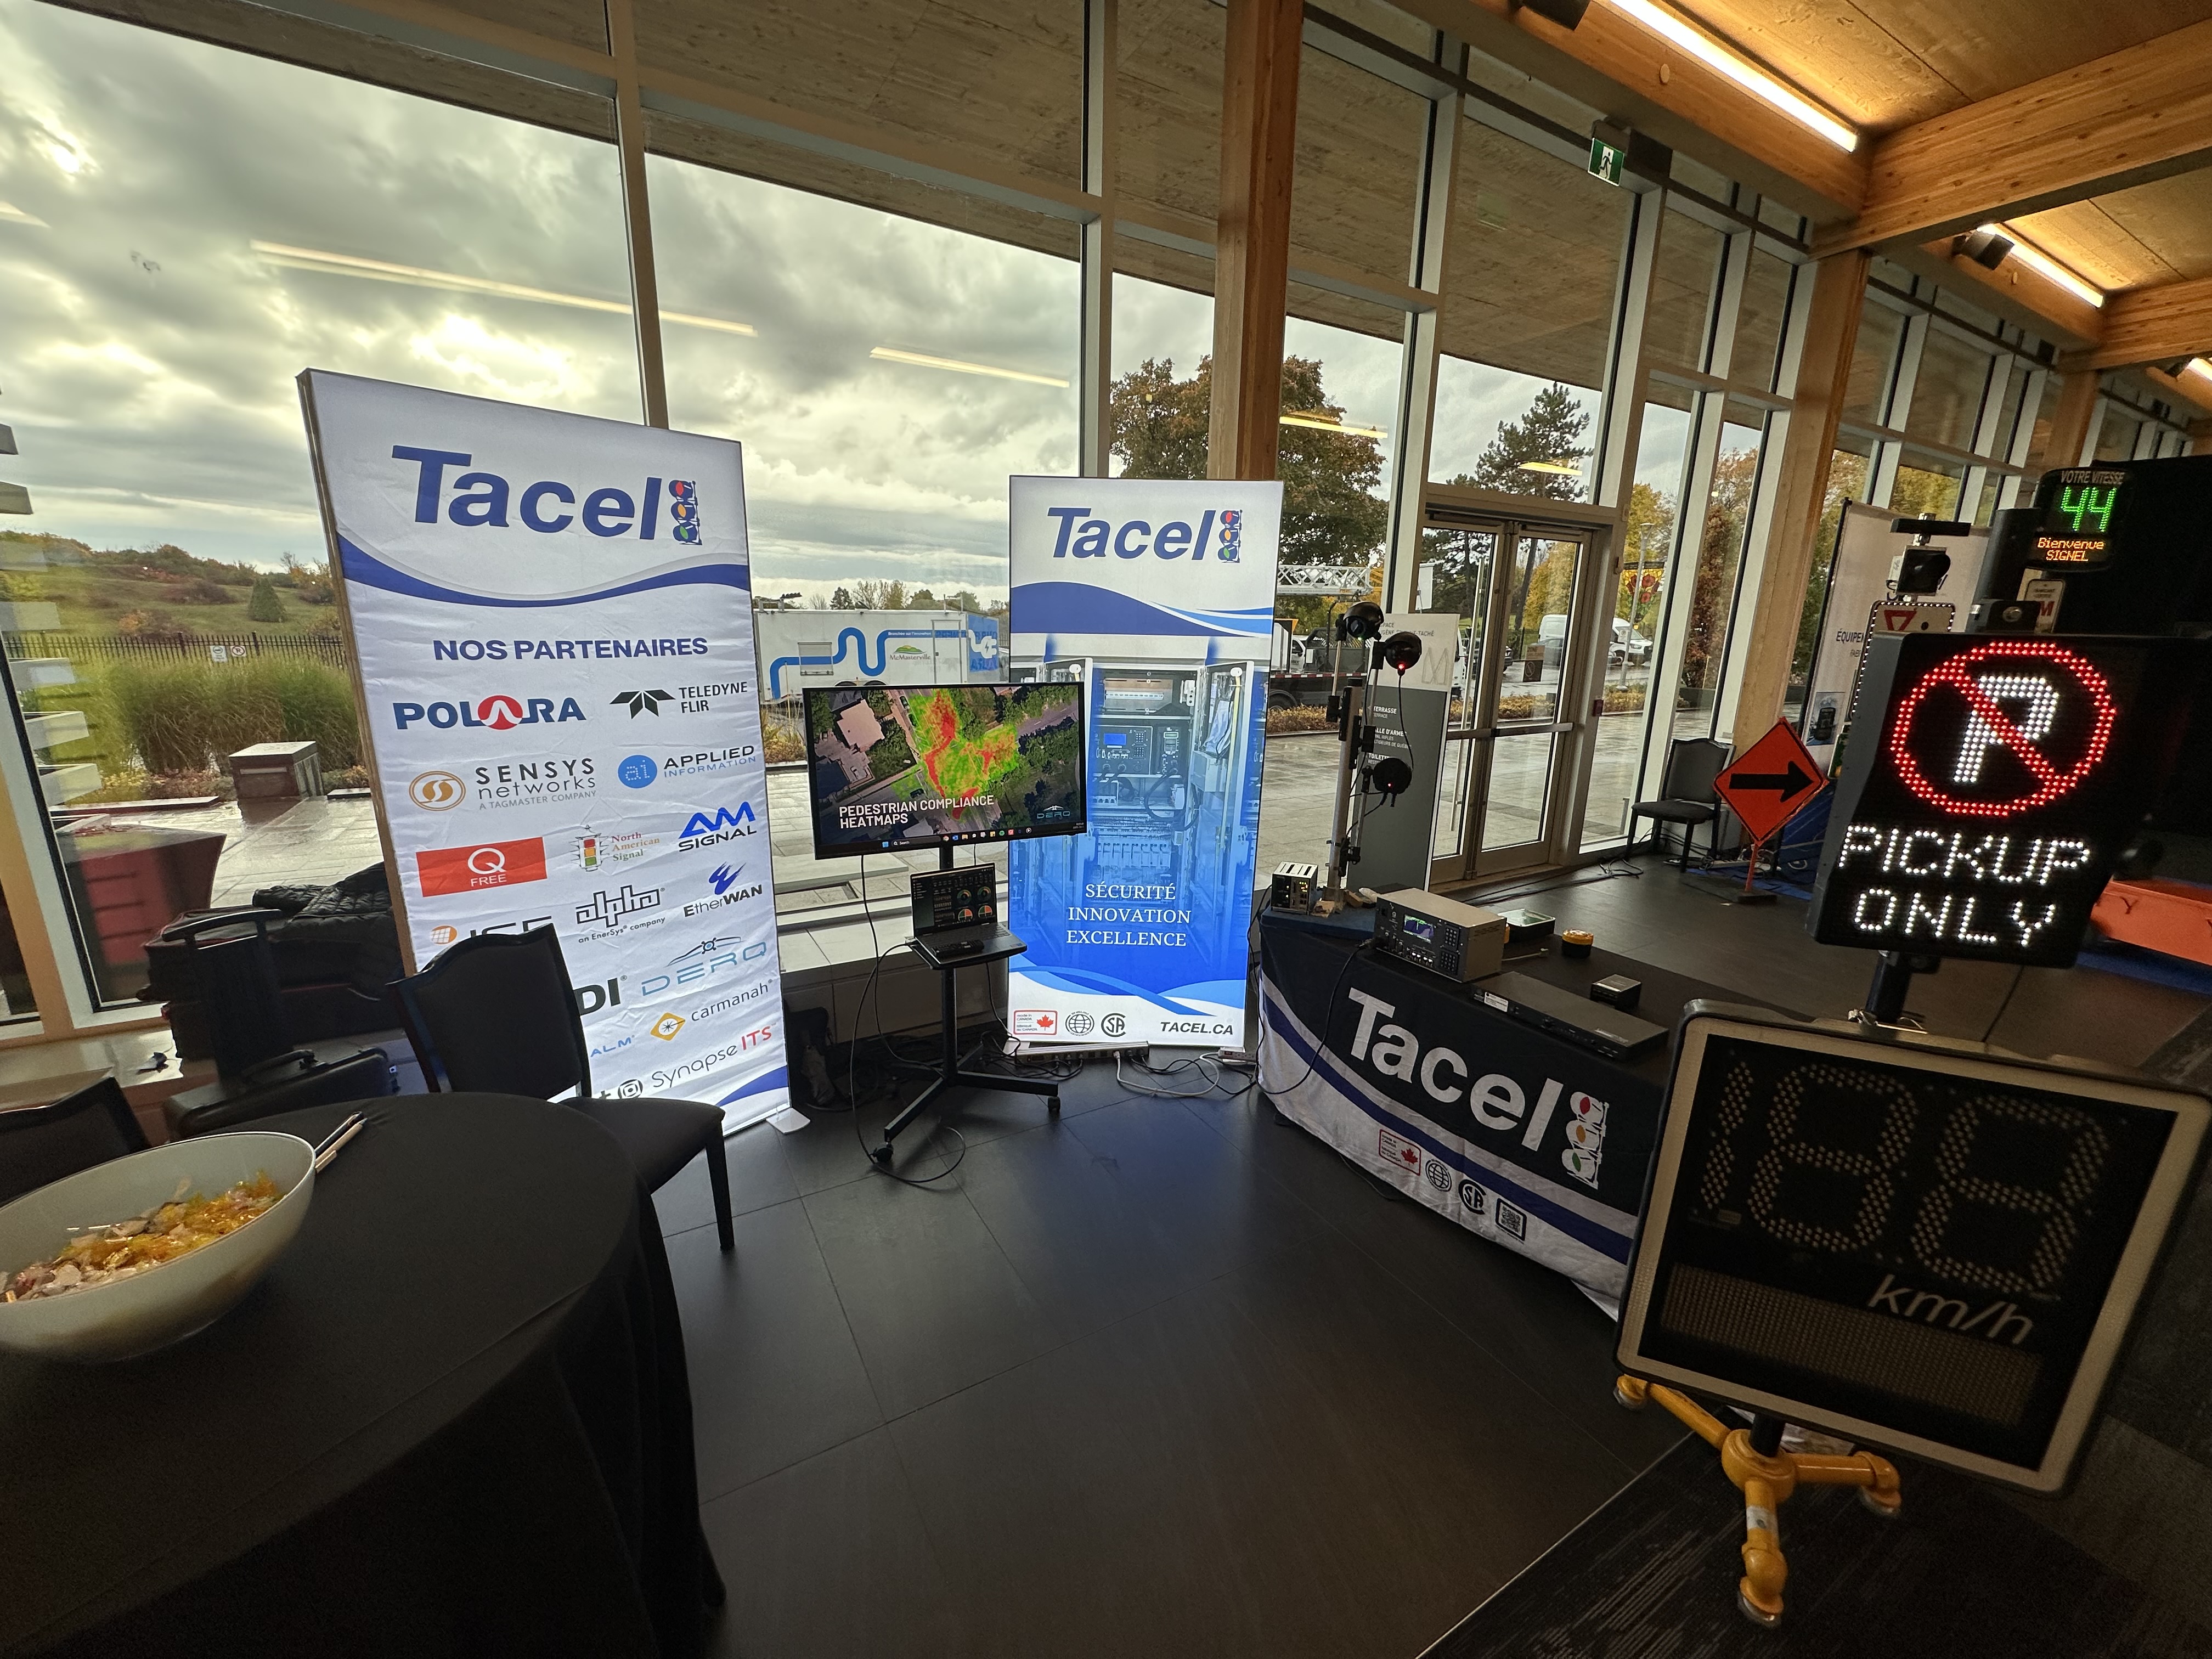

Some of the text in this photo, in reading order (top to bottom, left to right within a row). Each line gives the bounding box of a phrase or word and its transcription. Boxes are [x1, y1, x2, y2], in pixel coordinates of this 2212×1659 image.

[2061, 470, 2125, 485] VOTRE VITESSE
[392, 445, 662, 540] Tacel
[2060, 485, 2117, 533] 44
[1047, 507, 1216, 561] Tacel
[2037, 537, 2105, 550] Bienvenue
[2046, 550, 2089, 562] SIGNEL
[1836, 628, 1864, 644] ÉQUIPE
[433, 637, 708, 661] NOS PARTENAIRES
[679, 681, 748, 699] TELEDYNE
[393, 695, 586, 730] POLARA
[681, 700, 709, 714] FLIR
[1373, 706, 1397, 714] TERRASSE
[663, 745, 755, 770] APPLIED
[664, 756, 756, 778] INFORMATION
[476, 758, 595, 785] SENSYS
[478, 776, 595, 799] networks
[488, 796, 548, 809] TAGMASTER
[551, 790, 596, 802] COMPANY
[839, 795, 995, 817] PEDESTRIAN COMPLIANCE
[679, 802, 756, 839] AM
[840, 813, 909, 829] HEATMAPS
[611, 832, 642, 843] North
[612, 837, 660, 851] American
[678, 825, 757, 852] SIGNAL
[467, 847, 507, 874] Q
[613, 848, 644, 862] Signal
[1838, 825, 2090, 885] PICKUP
[470, 873, 507, 887] FREE
[1085, 881, 1176, 900] SÉCURITÉ
[683, 884, 763, 917] EtherWAN
[630, 917, 665, 930] company
[1068, 907, 1192, 923] INNOVATION
[1854, 887, 2056, 946] ONLY
[1066, 930, 1187, 947] EXCELLENCE
[1160, 1022, 1234, 1035] TACEL.CA
[652, 1025, 772, 1088] Synapse ITS
[1348, 986, 1564, 1152] Tacel
[1867, 1273, 2033, 1345] km/h
